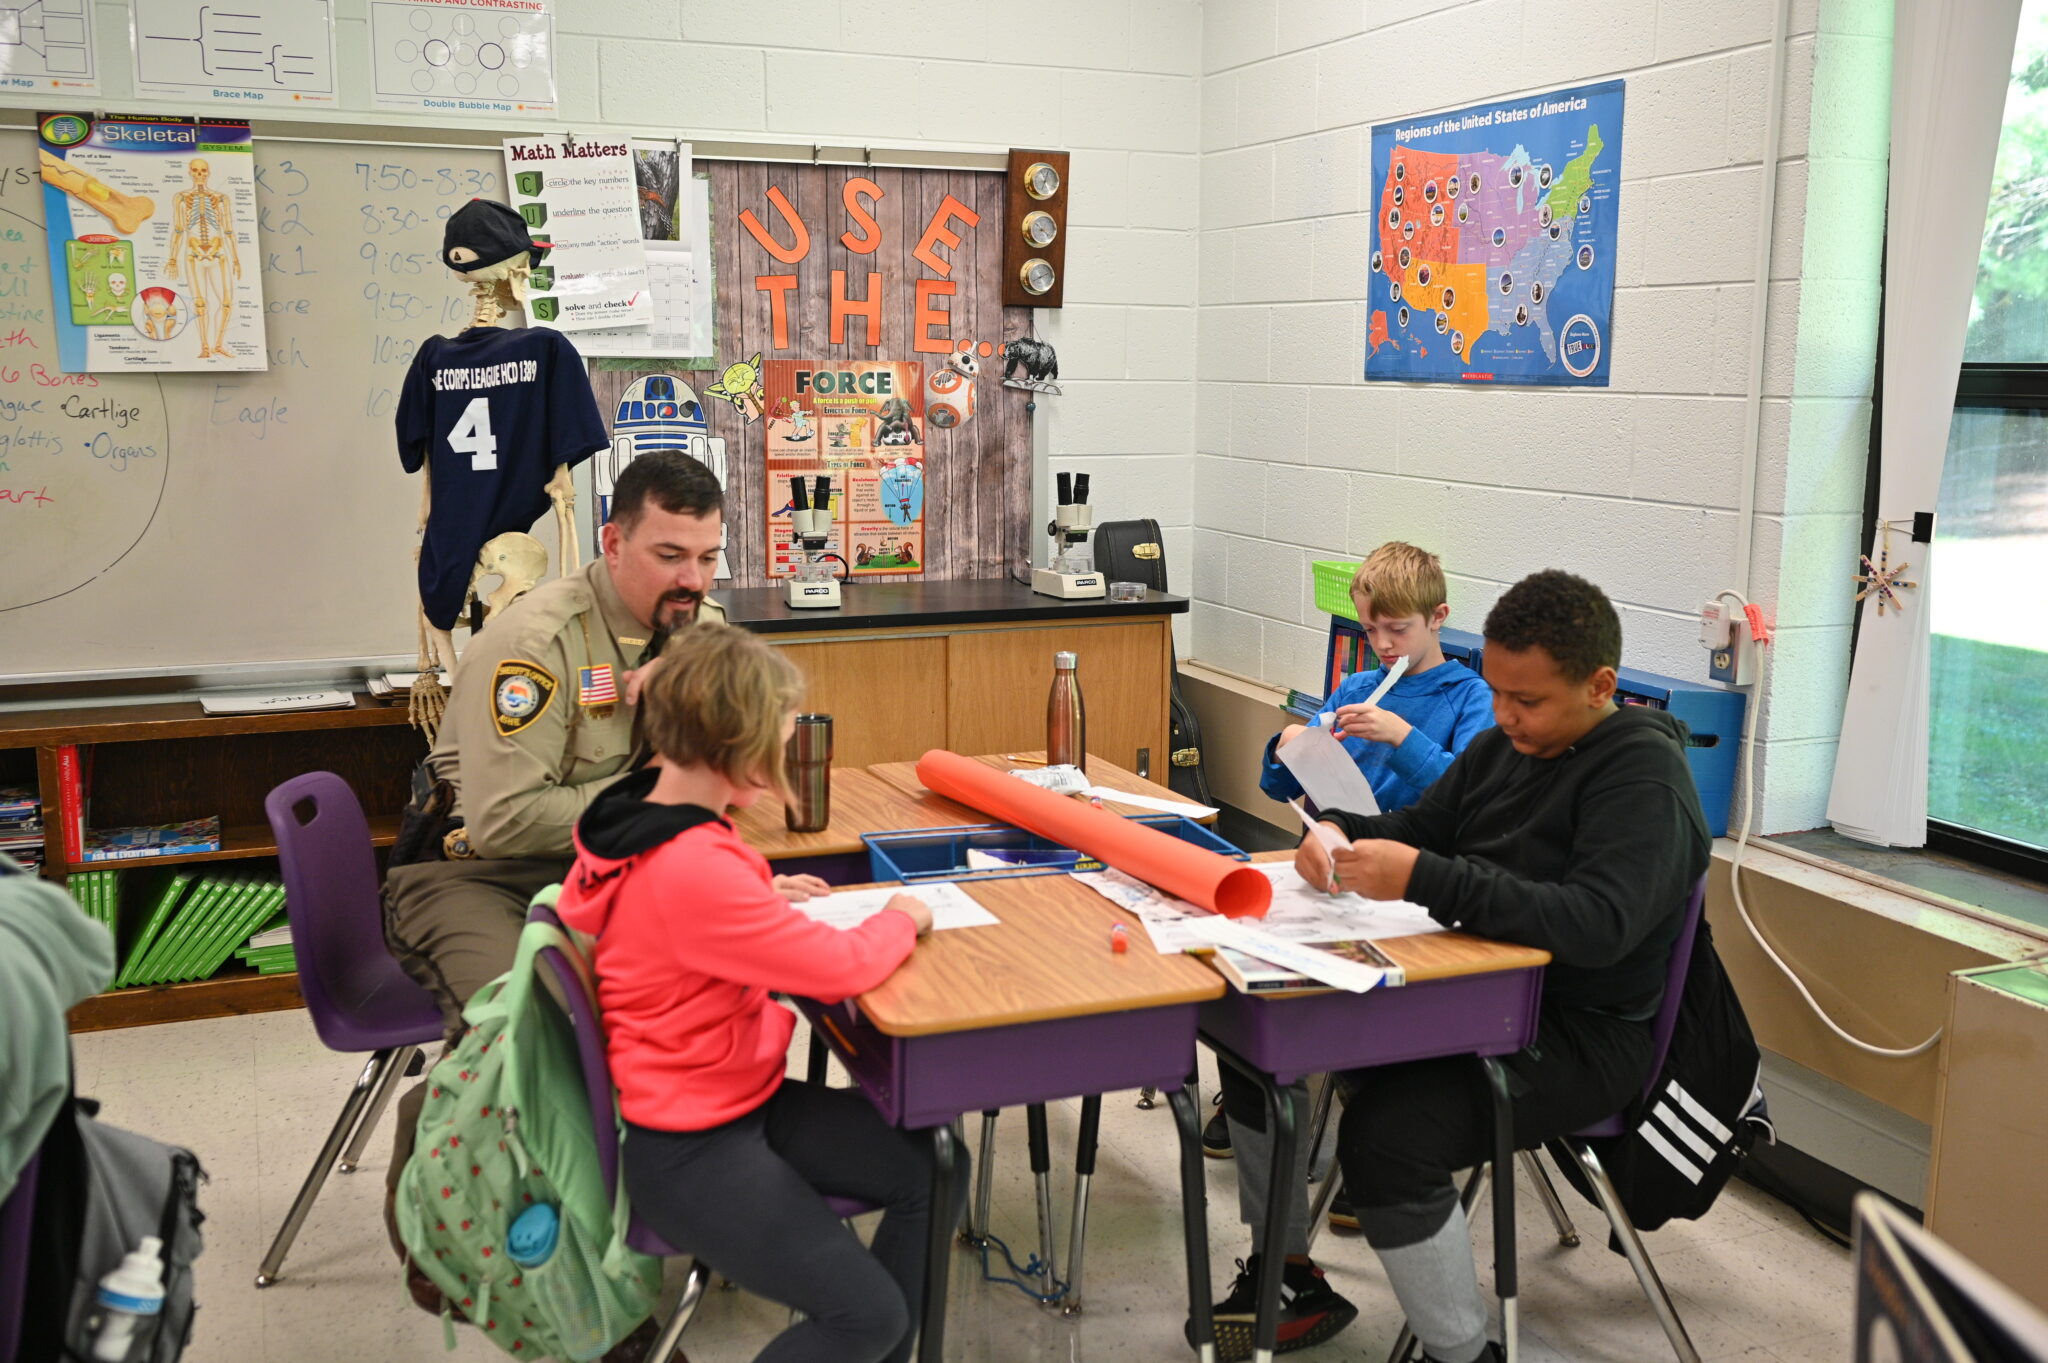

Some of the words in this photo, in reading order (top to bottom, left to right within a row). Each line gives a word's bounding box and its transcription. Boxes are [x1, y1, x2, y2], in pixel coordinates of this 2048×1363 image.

[12, 78, 34, 89] Map
[213, 88, 241, 98] Brace
[243, 90, 264, 101] Map
[424, 98, 456, 108] Double
[458, 100, 490, 110] Bubble
[492, 102, 513, 113] Map
[160, 116, 183, 124] Body
[1395, 126, 1431, 143] Regions
[1433, 121, 1444, 135] of
[1444, 119, 1460, 133] the
[1461, 111, 1492, 131] United
[1494, 108, 1528, 125] States
[1529, 104, 1542, 119] of
[1542, 96, 1588, 117] America
[103, 125, 196, 144] Skeletal
[202, 144, 244, 152] SYSTEM
[510, 144, 557, 162] Math
[561, 141, 628, 159] Matters
[279, 160, 310, 197] 3
[521, 174, 533, 194] C
[548, 179, 569, 187] circle
[569, 178, 582, 187] the
[583, 177, 597, 189] key
[598, 175, 630, 185] numbers
[279, 203, 315, 236] 2
[525, 208, 536, 226] U
[552, 207, 587, 217] underline
[588, 205, 602, 215] the
[602, 204, 633, 216] question
[620, 236, 641, 246] words
[534, 271, 546, 289] E
[263, 298, 309, 316] ore
[538, 302, 550, 319] S
[564, 302, 587, 312] solve
[587, 301, 603, 310] and
[603, 298, 629, 310] check
[30, 363, 101, 388] Bones
[443, 368, 470, 391] CORPS
[470, 364, 501, 389] LEAGUE
[500, 361, 518, 385] HCD
[519, 359, 538, 382] 1389
[795, 369, 892, 395] FORCE
[62, 394, 141, 429] Cartlige
[209, 384, 289, 440] Eagle
[446, 397, 498, 471] 4
[91, 851, 107, 861] ASK
[106, 850, 119, 860] ME
[118, 847, 161, 860] EVERYTHING
